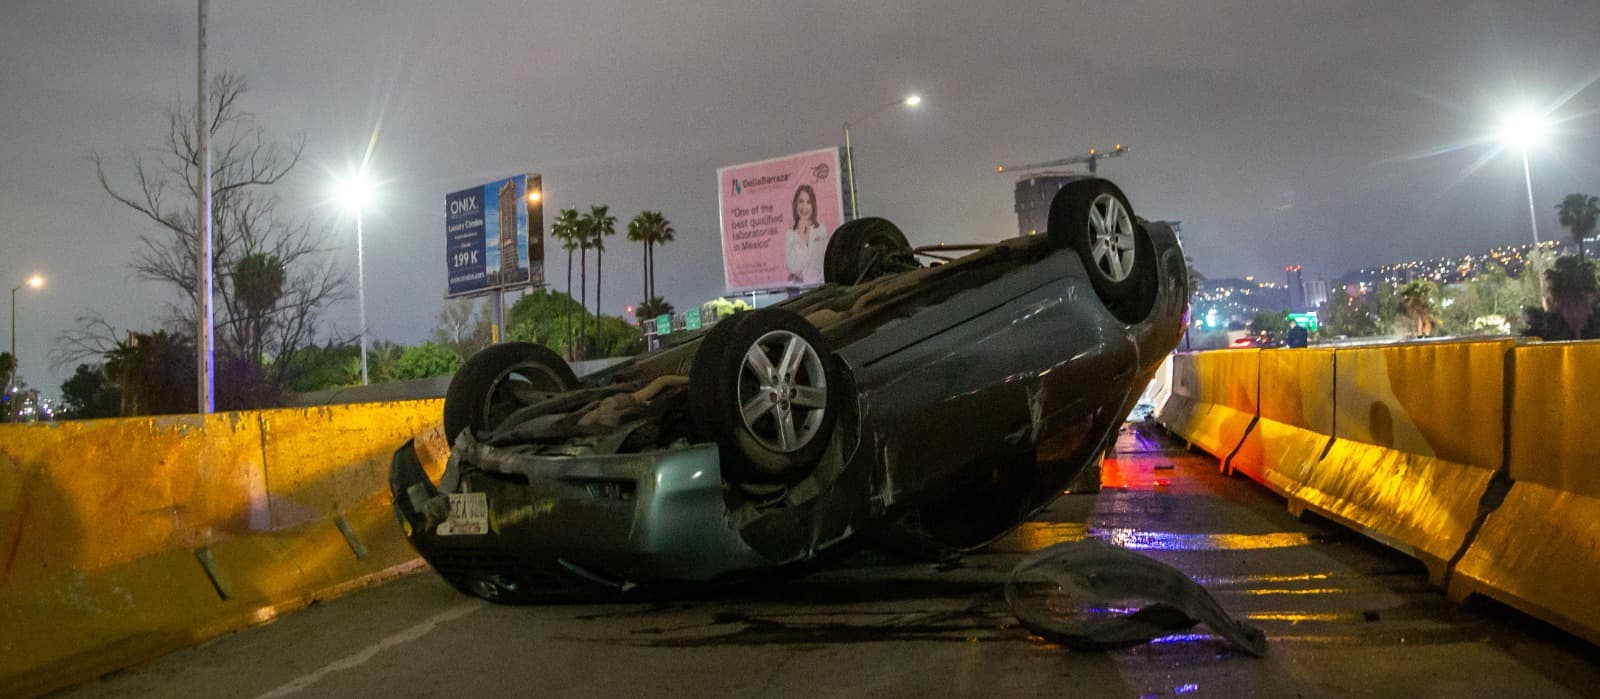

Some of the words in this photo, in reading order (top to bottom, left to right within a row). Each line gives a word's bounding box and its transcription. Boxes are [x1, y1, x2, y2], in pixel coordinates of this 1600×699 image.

[751, 204, 759, 215] of
[760, 204, 774, 213] the
[448, 222, 465, 233] Luxury
[731, 219, 748, 229] best
[749, 214, 783, 229] qualified
[732, 227, 778, 241] laboratories
[733, 243, 741, 252] in
[454, 252, 469, 268] 199
